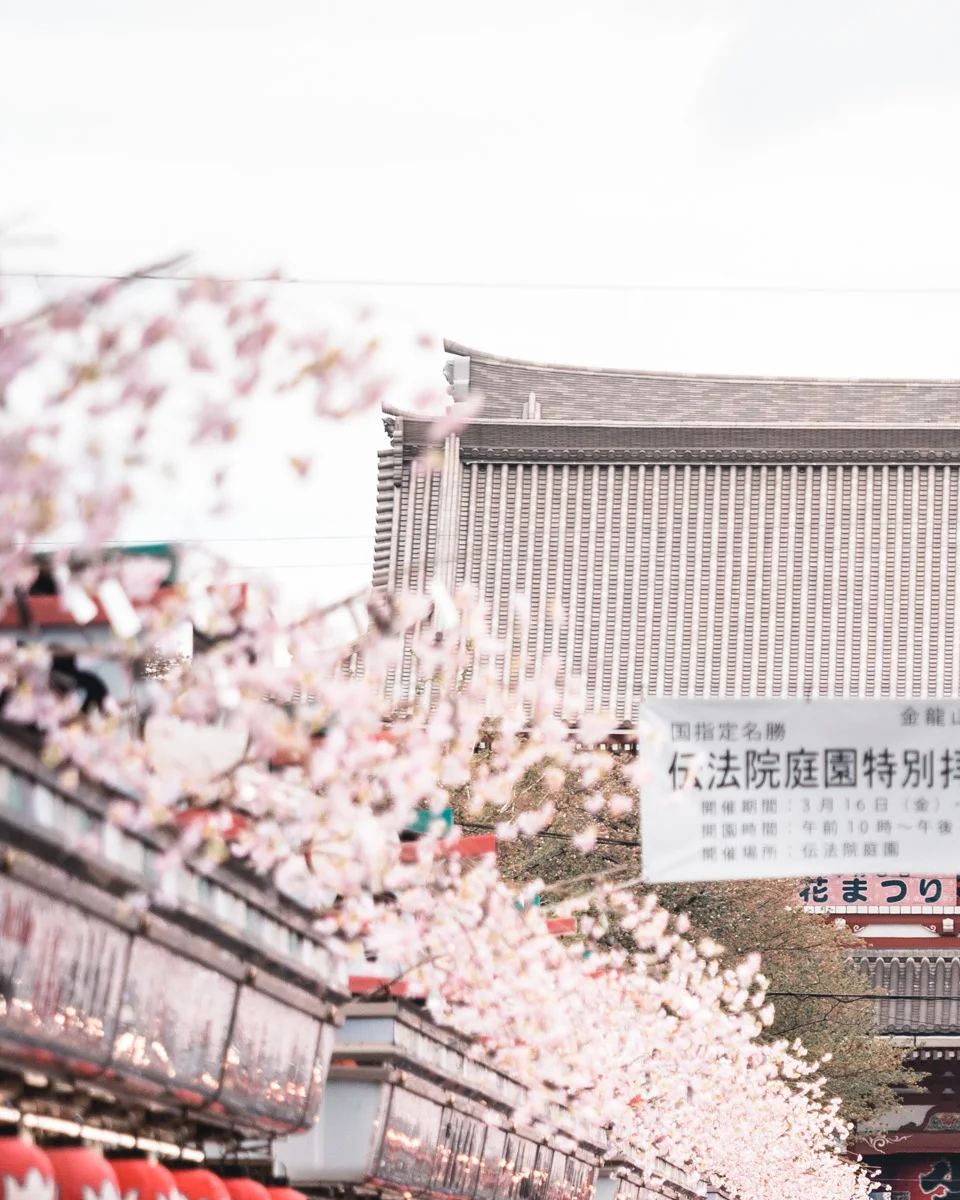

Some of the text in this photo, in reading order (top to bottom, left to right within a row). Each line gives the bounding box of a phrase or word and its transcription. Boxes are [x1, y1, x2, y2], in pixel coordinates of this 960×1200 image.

[671, 722, 786, 742] 国指定名勝
[799, 877, 942, 903] 花まつり
